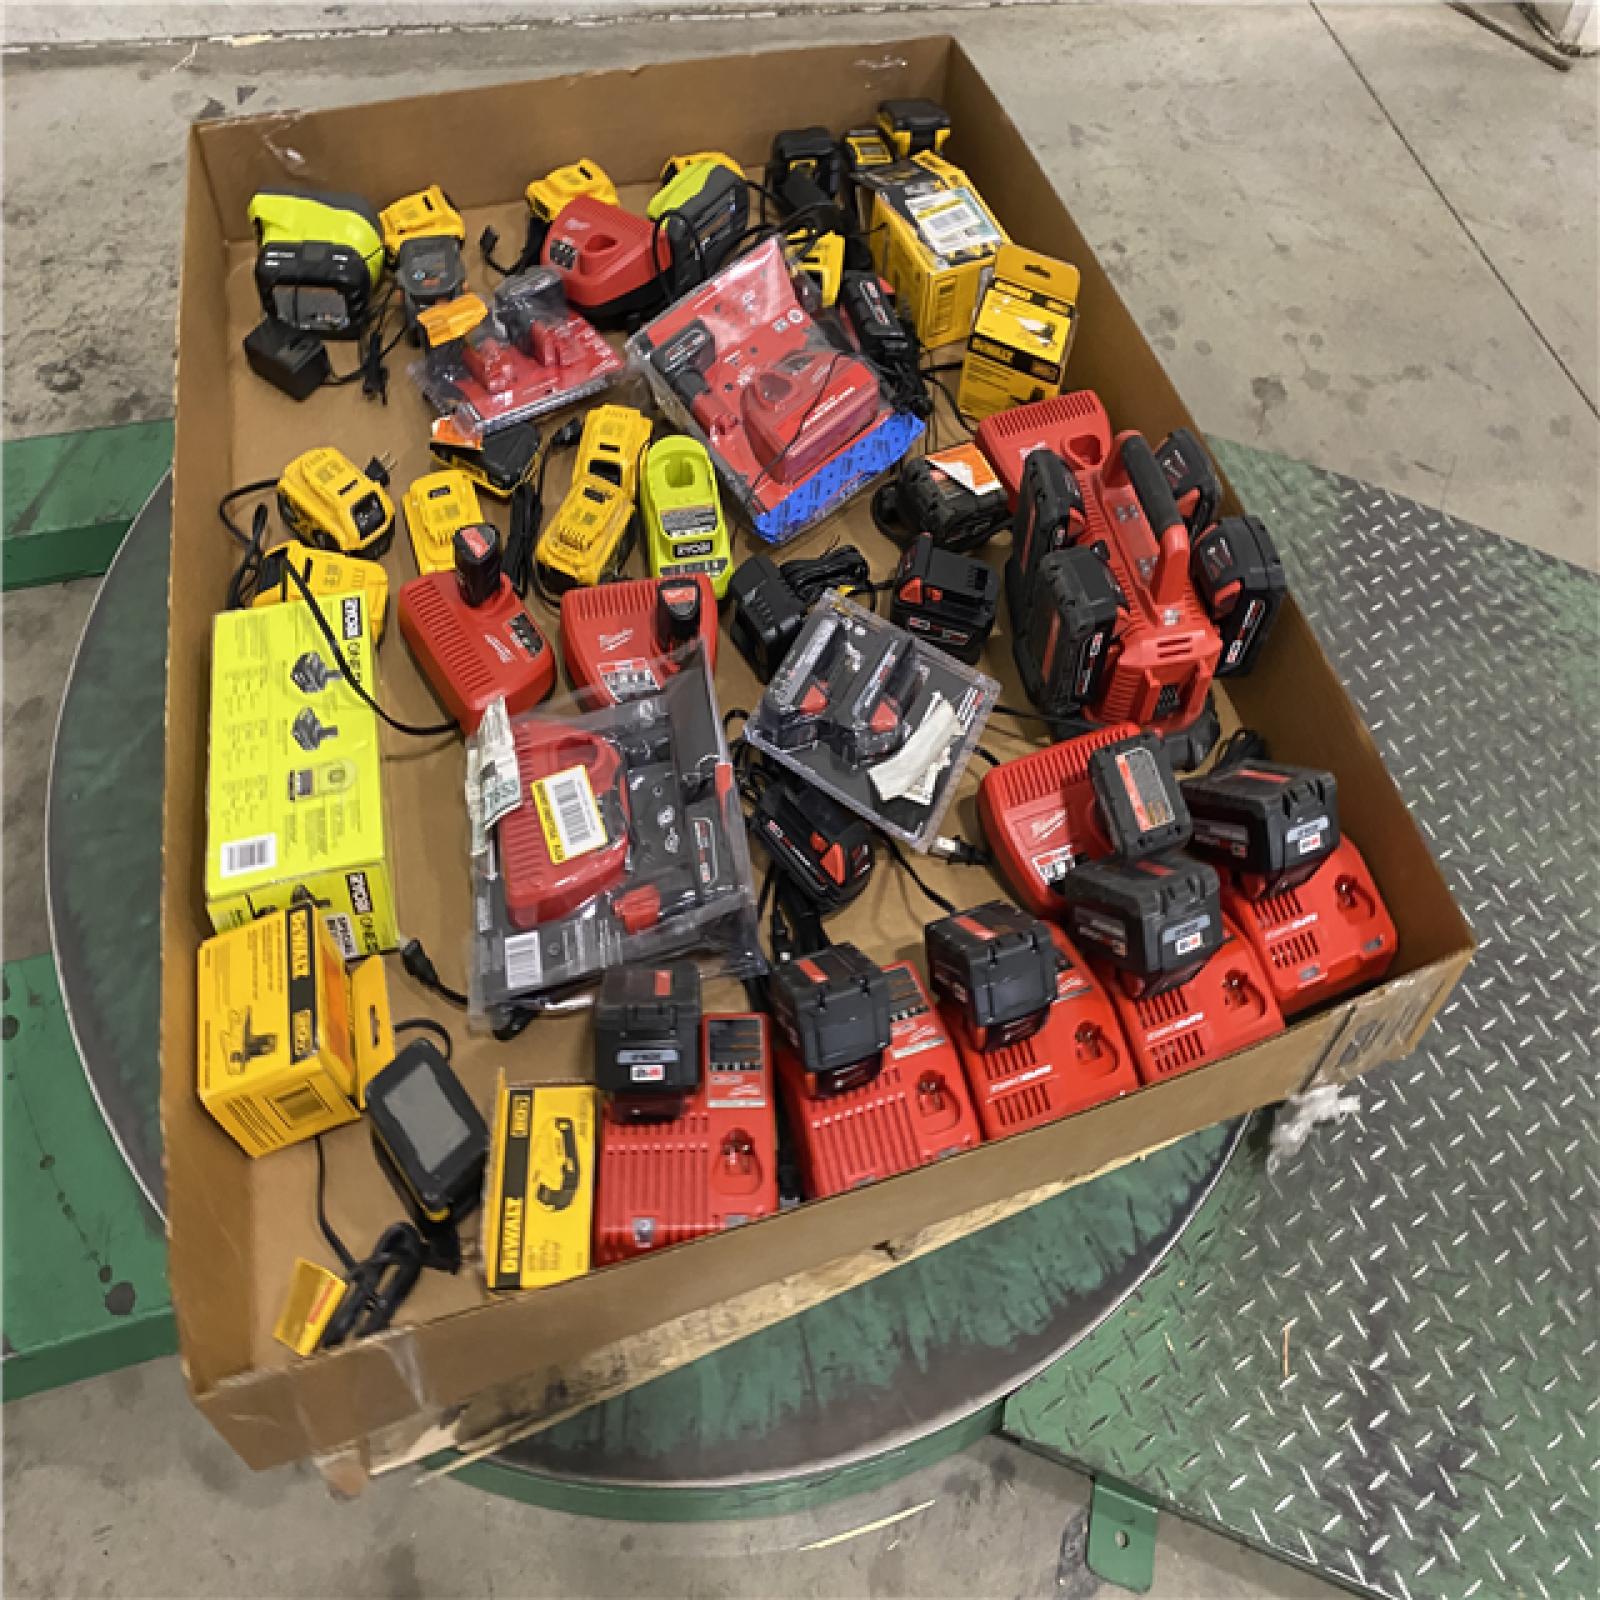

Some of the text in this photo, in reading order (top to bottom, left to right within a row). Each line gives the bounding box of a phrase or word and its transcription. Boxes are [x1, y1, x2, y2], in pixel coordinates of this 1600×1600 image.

[676, 541, 712, 556] RYOBI
[343, 598, 361, 638] RYOBI
[350, 874, 371, 912] RYOBI
[290, 910, 309, 979] DEWALT
[501, 1198, 522, 1272] DEWALT
